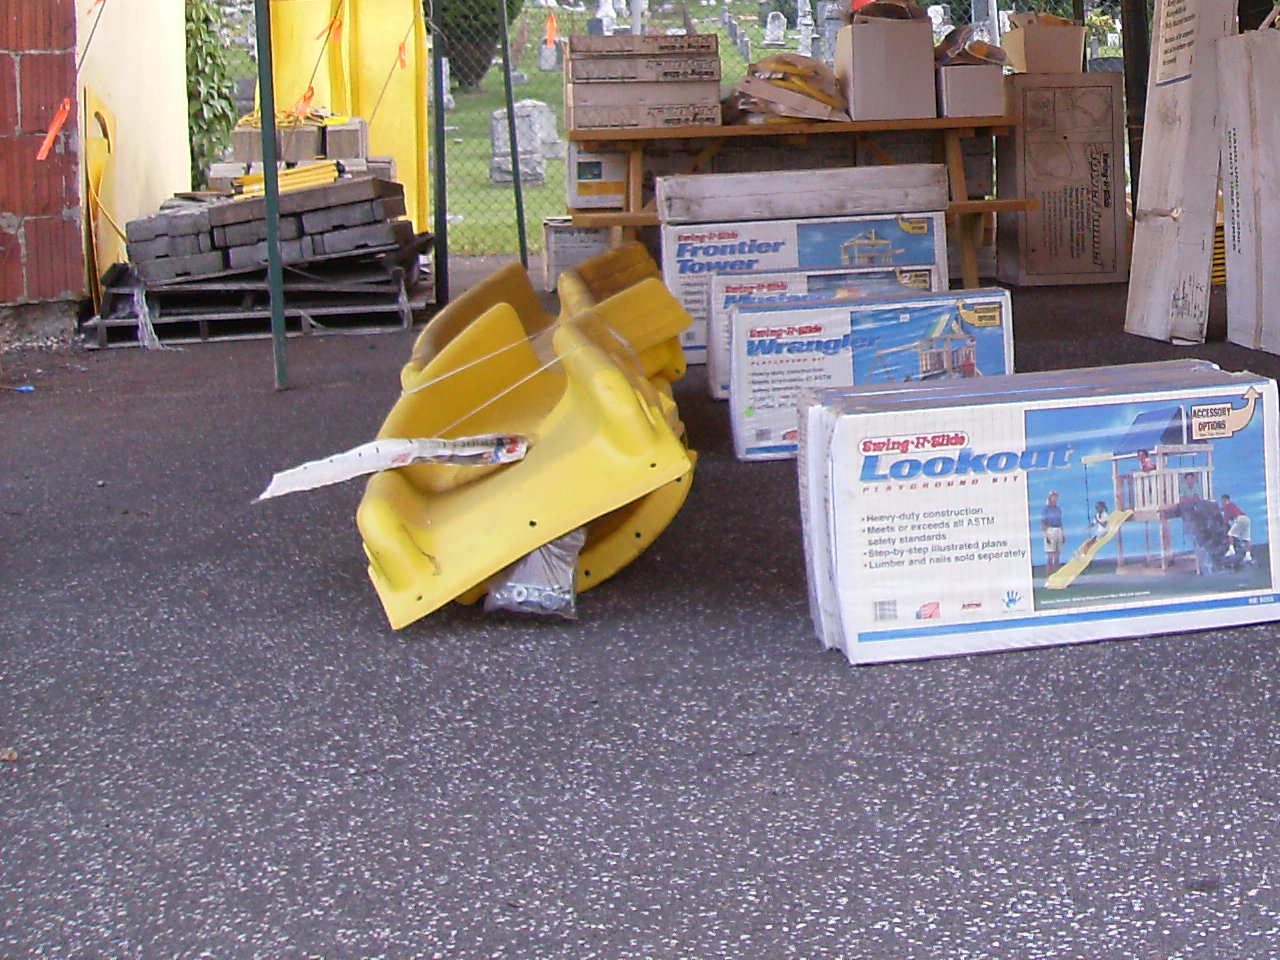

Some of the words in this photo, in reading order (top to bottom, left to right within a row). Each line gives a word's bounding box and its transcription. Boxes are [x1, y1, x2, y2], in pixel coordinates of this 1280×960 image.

[676, 239, 785, 258] Frontier
[676, 259, 759, 274] Tower
[1192, 407, 1232, 419] ACCESSORY
[859, 445, 1076, 483] Lookout
[862, 478, 979, 494] PLAYGROUND
[992, 474, 1019, 484] KIT
[866, 511, 920, 524] Heavy-duty
[923, 506, 983, 519] construction
[867, 525, 895, 534] Meets
[898, 524, 908, 532] or
[911, 520, 950, 531] exceeds
[967, 516, 995, 527] ASTM
[868, 536, 896, 547] safety
[899, 532, 947, 544] standards
[868, 546, 929, 558] Step-by-step
[981, 539, 1008, 550] plans
[869, 557, 906, 569] Lumber
[908, 555, 926, 566] and
[929, 554, 952, 565] nails
[954, 552, 975, 563] sold
[977, 549, 1027, 562] separately
